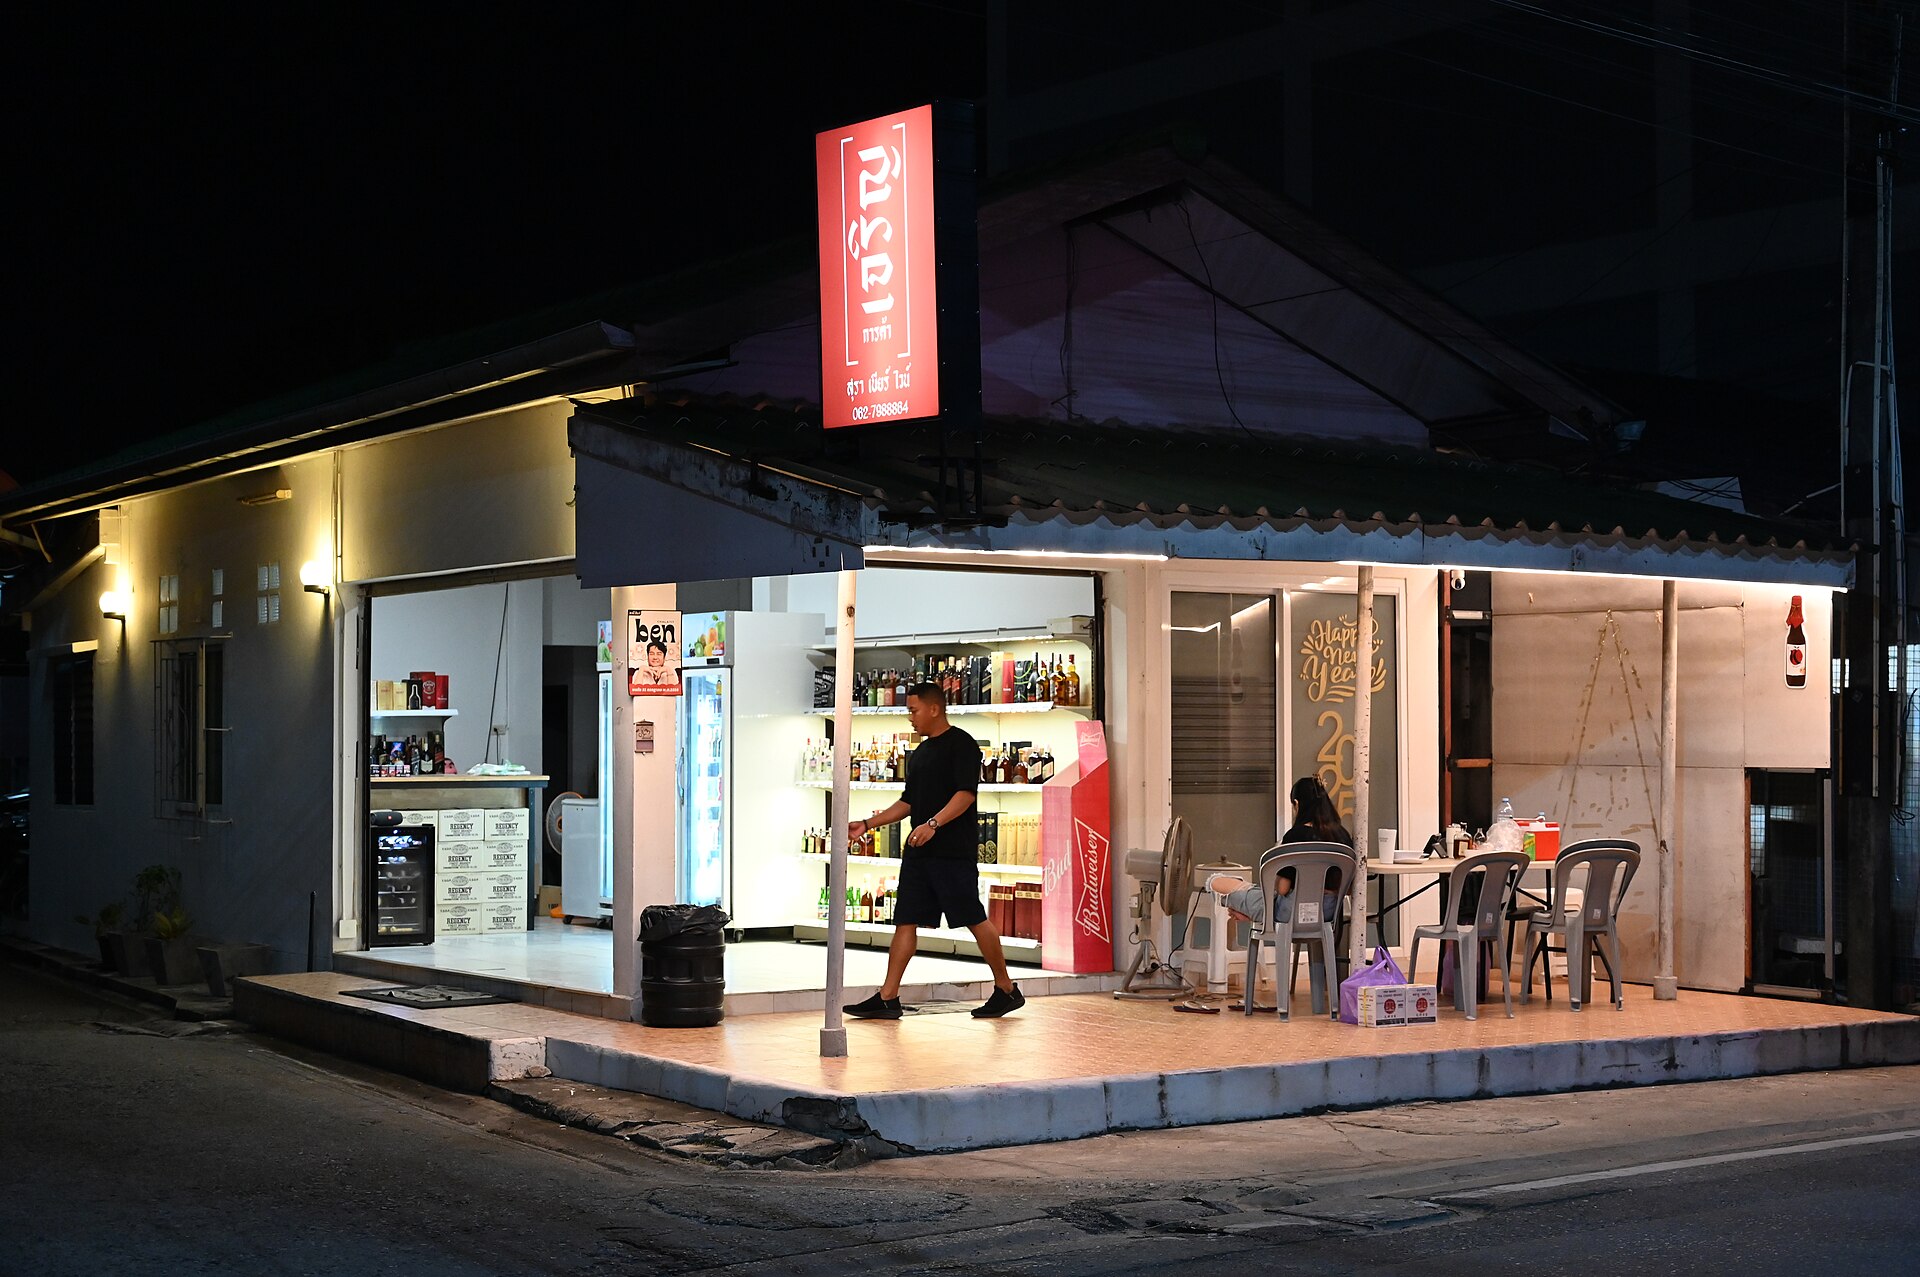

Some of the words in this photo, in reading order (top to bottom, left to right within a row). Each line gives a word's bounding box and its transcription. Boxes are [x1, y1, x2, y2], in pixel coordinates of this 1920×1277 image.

[848, 145, 901, 314] เจริญ
[862, 315, 892, 344] การค้า
[847, 378, 864, 402] สุรา
[868, 365, 891, 393] เบียร์
[893, 362, 912, 389] ไวน์
[635, 619, 675, 643] ben
[1311, 616, 1378, 651] Happ
[1303, 655, 1376, 702] Yea
[495, 822, 519, 830] REGENCY
[448, 855, 473, 863] REGENCY
[492, 853, 517, 861] REGENCY
[1041, 840, 1072, 897] Bud
[492, 885, 517, 893] REGENCY
[1083, 829, 1101, 937] Budweiser
[446, 917, 471, 925] REGENCY
